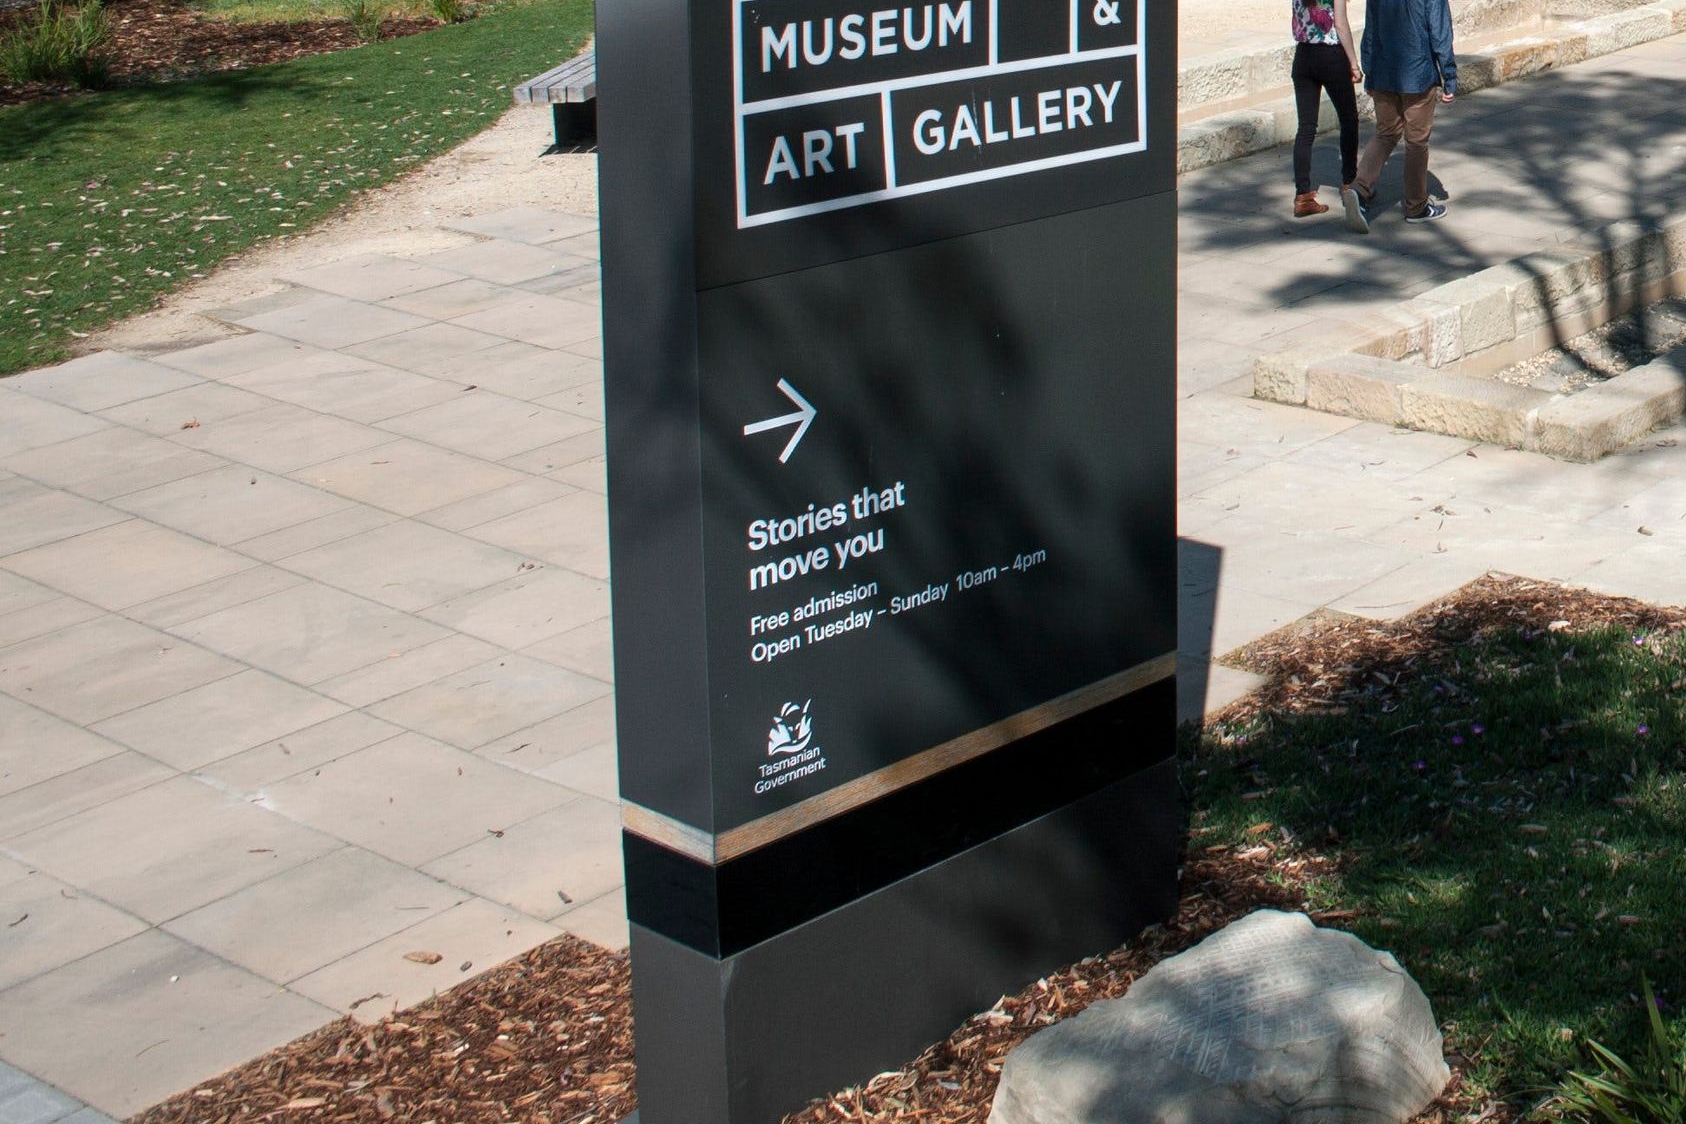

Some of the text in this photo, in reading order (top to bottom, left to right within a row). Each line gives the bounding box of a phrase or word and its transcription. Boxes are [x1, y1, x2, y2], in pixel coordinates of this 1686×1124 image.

[760, 0, 973, 73] MUSEUM
[762, 80, 1122, 186] ART GALLERY
[747, 480, 906, 552] Stories that
[749, 528, 884, 591] move you
[750, 635, 801, 664] Open
[804, 607, 874, 646] Tuesday
[890, 581, 949, 617] Sunday
[955, 566, 997, 593] 10am
[1012, 548, 1047, 574] 4pm
[750, 581, 878, 637] Free admission
[754, 756, 827, 795] Government
[758, 746, 821, 778] Tasmanian
